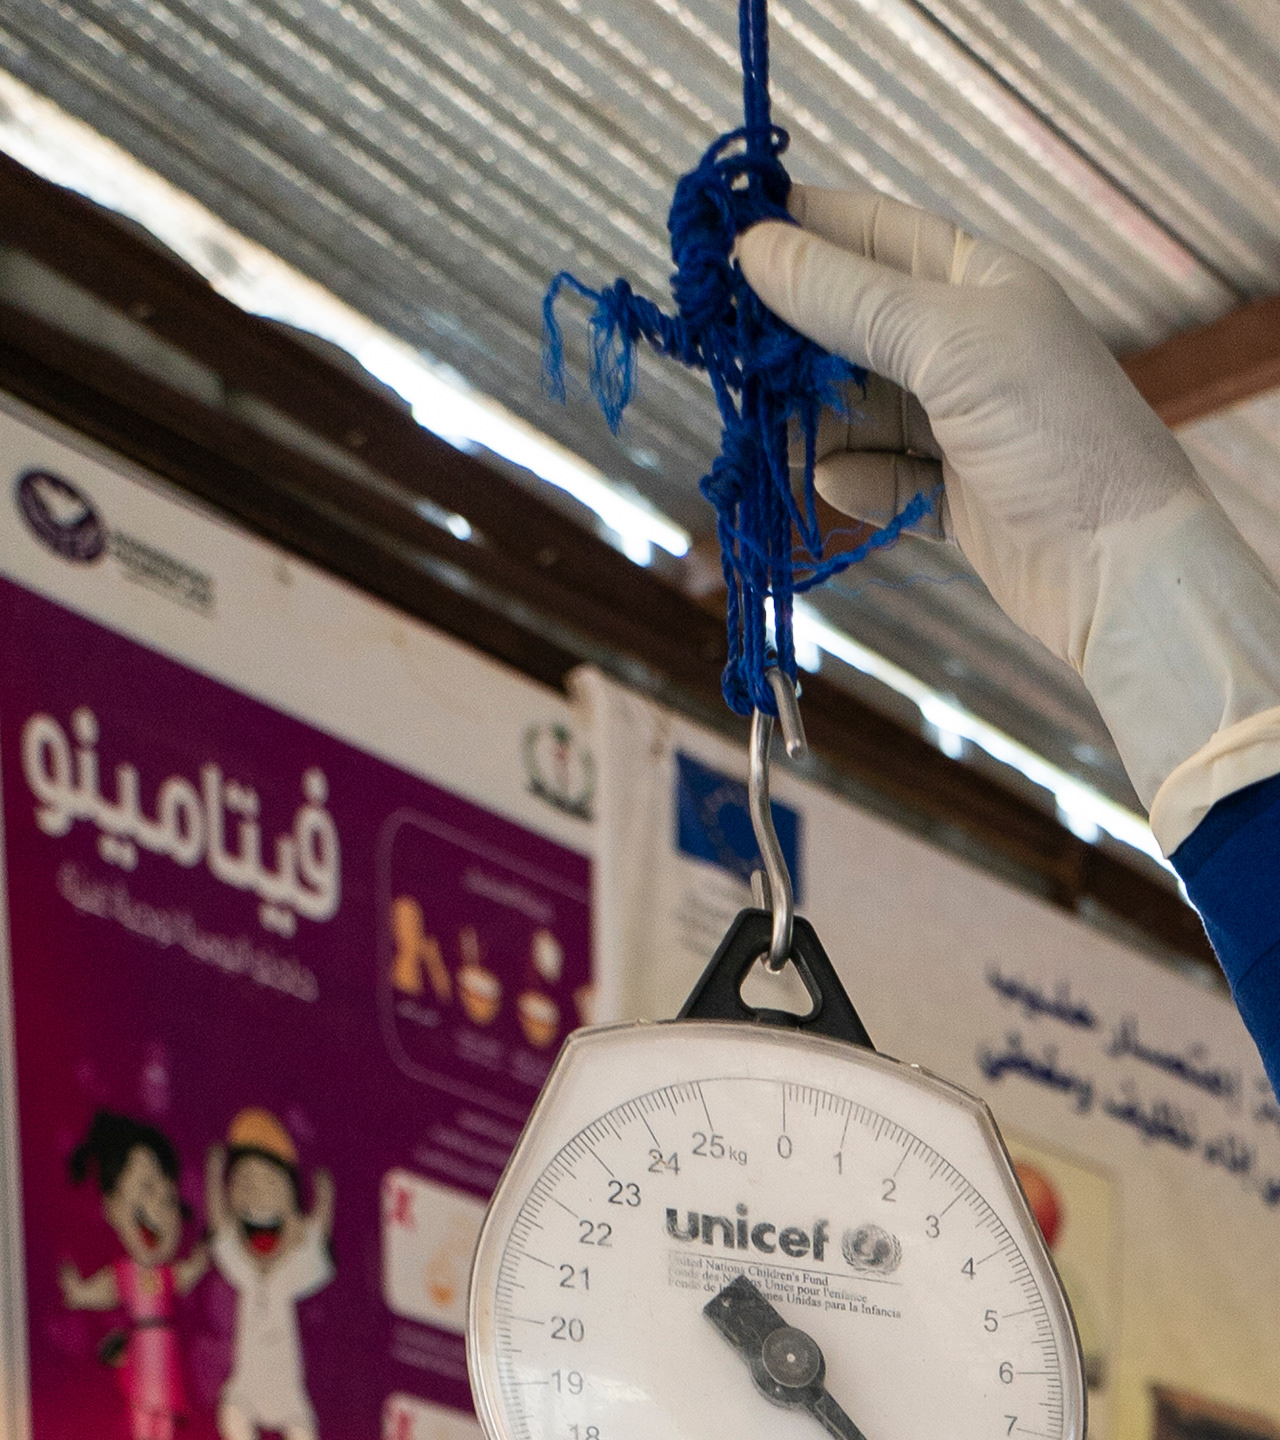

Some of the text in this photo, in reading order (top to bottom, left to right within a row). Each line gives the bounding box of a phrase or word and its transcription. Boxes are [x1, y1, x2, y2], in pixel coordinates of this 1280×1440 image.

[20, 707, 342, 937] فيتامينو
[691, 1132, 748, 1165] 25 kg
[777, 1134, 793, 1159] 0
[648, 1148, 681, 1176] 24
[832, 1151, 844, 1175] 1
[607, 1180, 642, 1207] 23
[881, 1178, 897, 1202] 2
[578, 1219, 613, 1247] 22
[665, 1202, 830, 1262] unicef
[925, 1215, 941, 1239] 3
[559, 1263, 590, 1290] 21
[748, 1265, 800, 1282] Children's
[802, 1273, 829, 1287] Fund
[961, 1256, 977, 1280] 4
[550, 1315, 585, 1342] 20
[984, 1309, 999, 1333] 5
[551, 1369, 584, 1395] 19
[999, 1361, 1014, 1384] 6
[1003, 1414, 1018, 1437] 7
